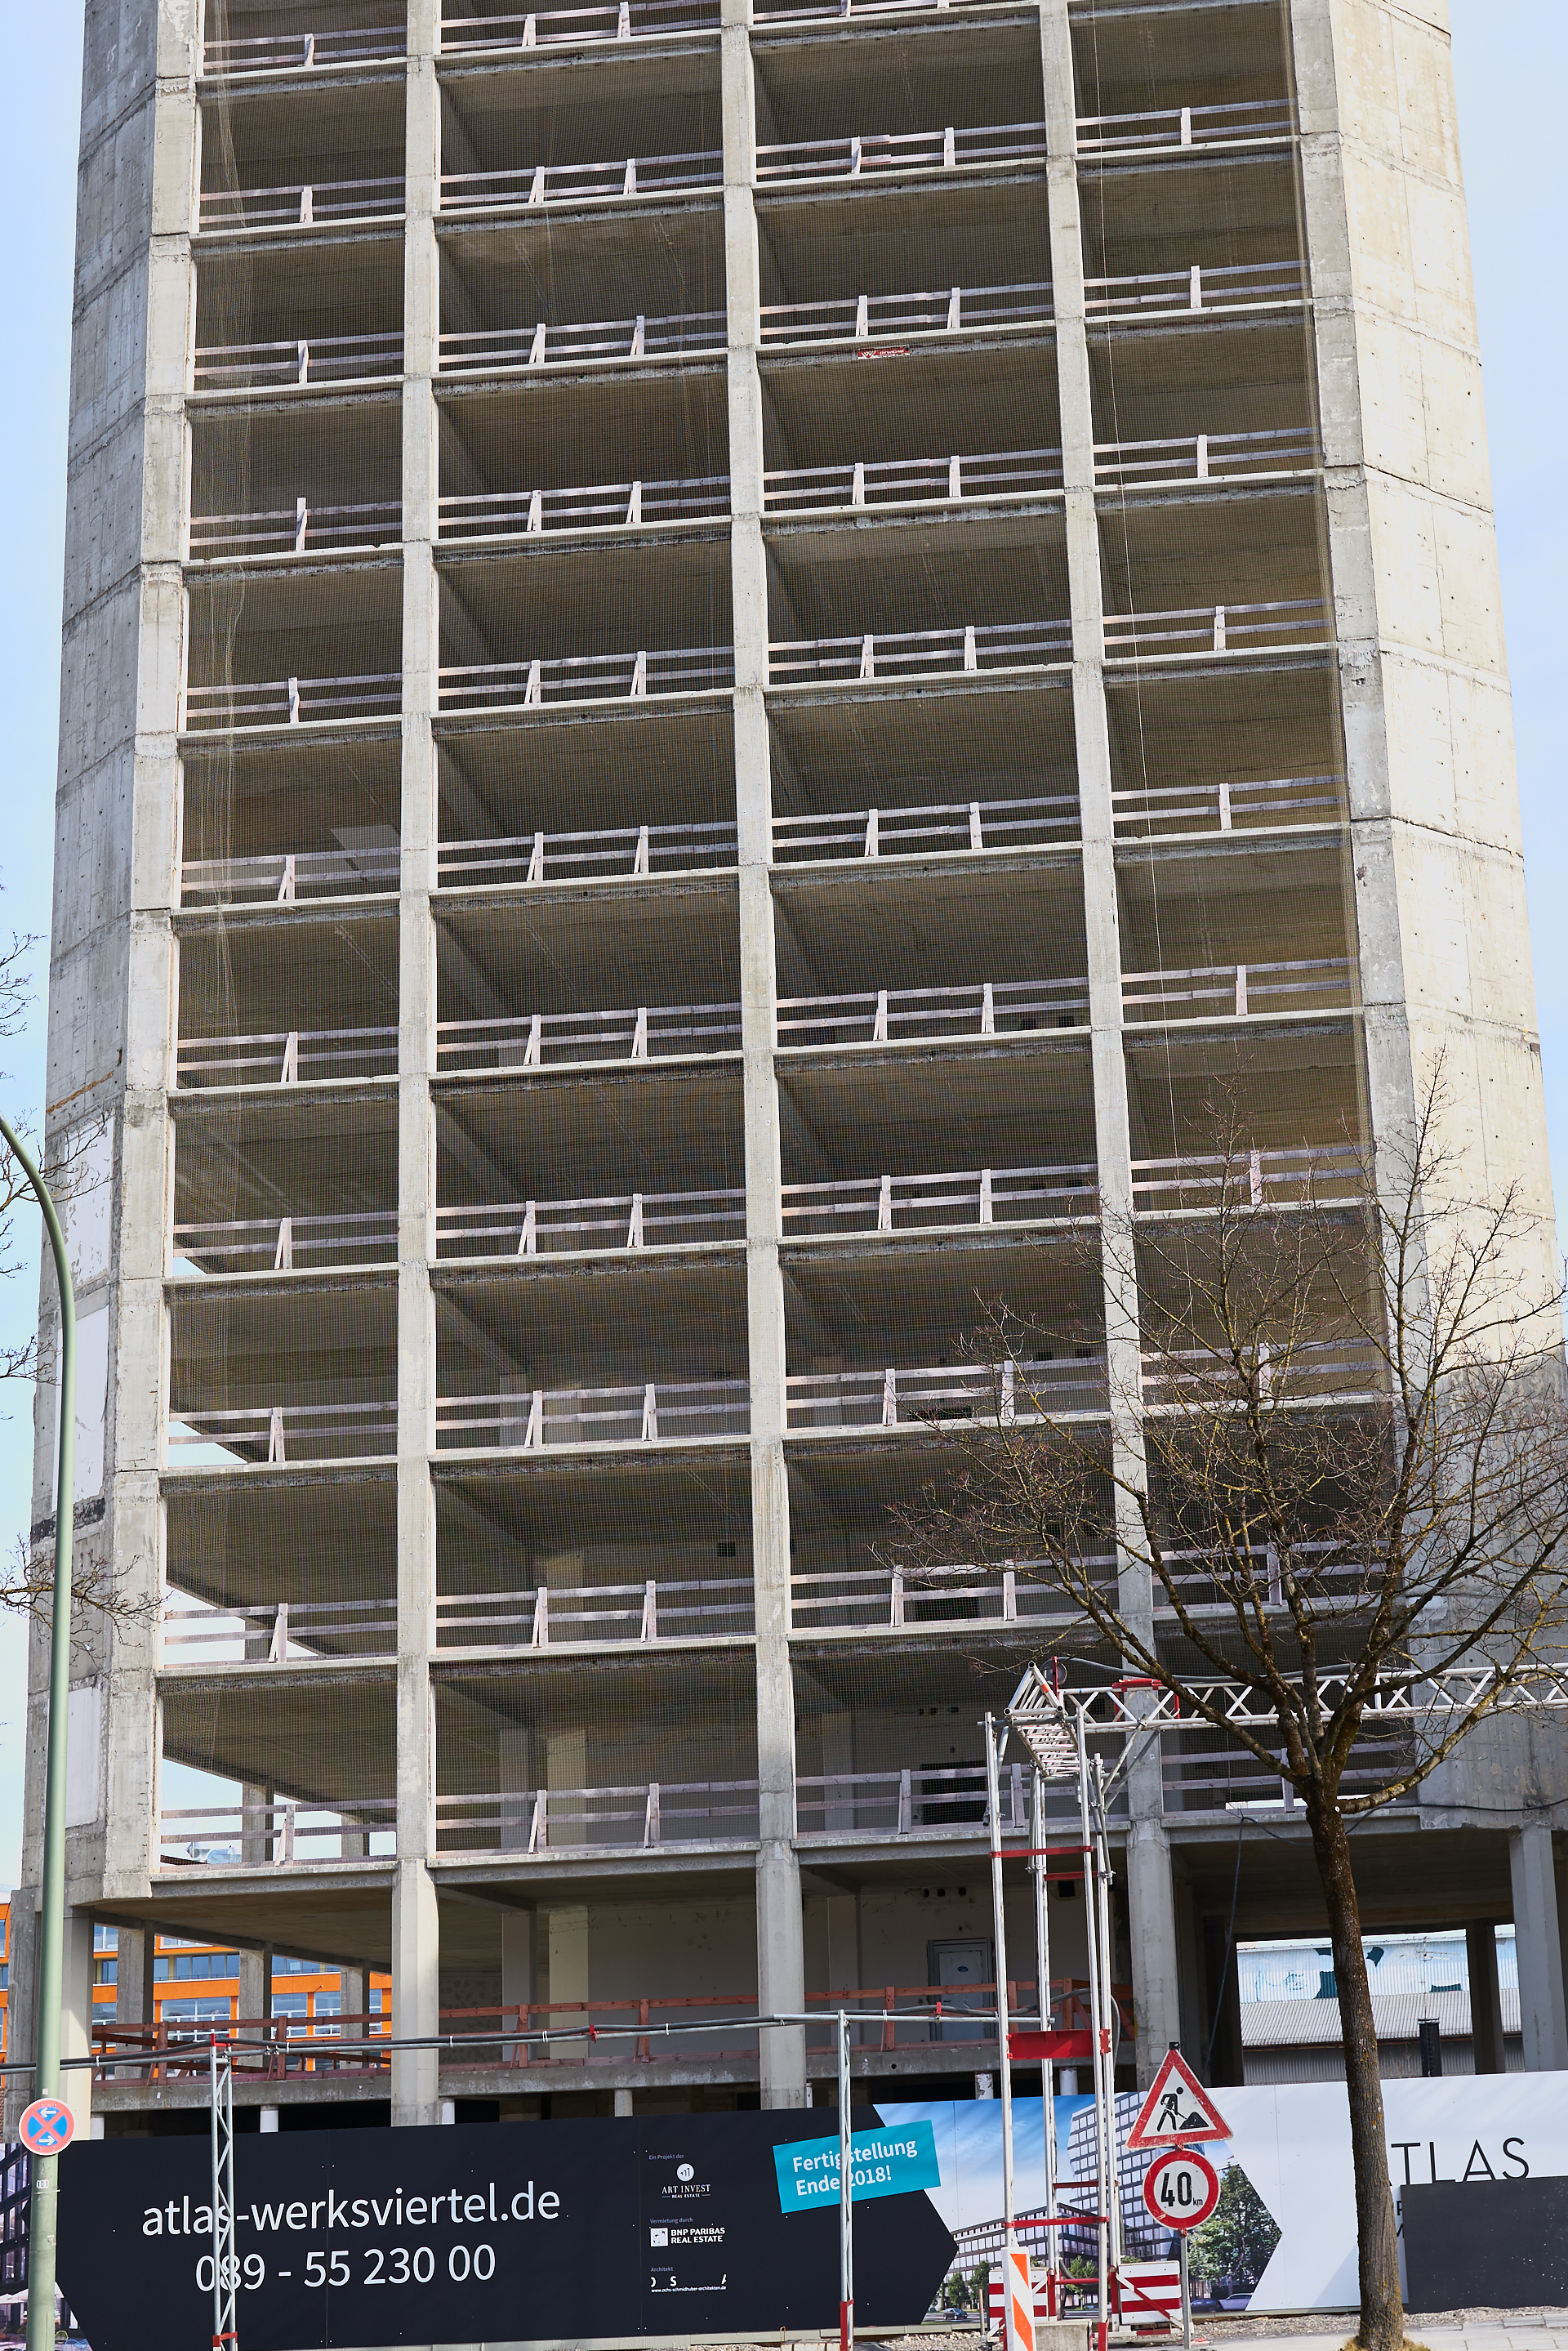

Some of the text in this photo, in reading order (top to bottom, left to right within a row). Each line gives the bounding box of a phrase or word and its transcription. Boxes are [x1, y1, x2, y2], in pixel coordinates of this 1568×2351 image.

[1388, 2137, 1530, 2186] TLAS
[662, 2184, 711, 2194] ART INVEST
[796, 2175, 840, 2196] Ende
[1160, 2171, 1204, 2207] 40 km
[143, 2181, 560, 2236] atlas-werksviertel.de
[690, 2227, 726, 2236] PARIBAS
[693, 2235, 724, 2243] ESTATE
[195, 2253, 265, 2292] 089
[304, 2251, 350, 2286] 55
[363, 2246, 435, 2284] 230
[448, 2244, 496, 2281] 00
